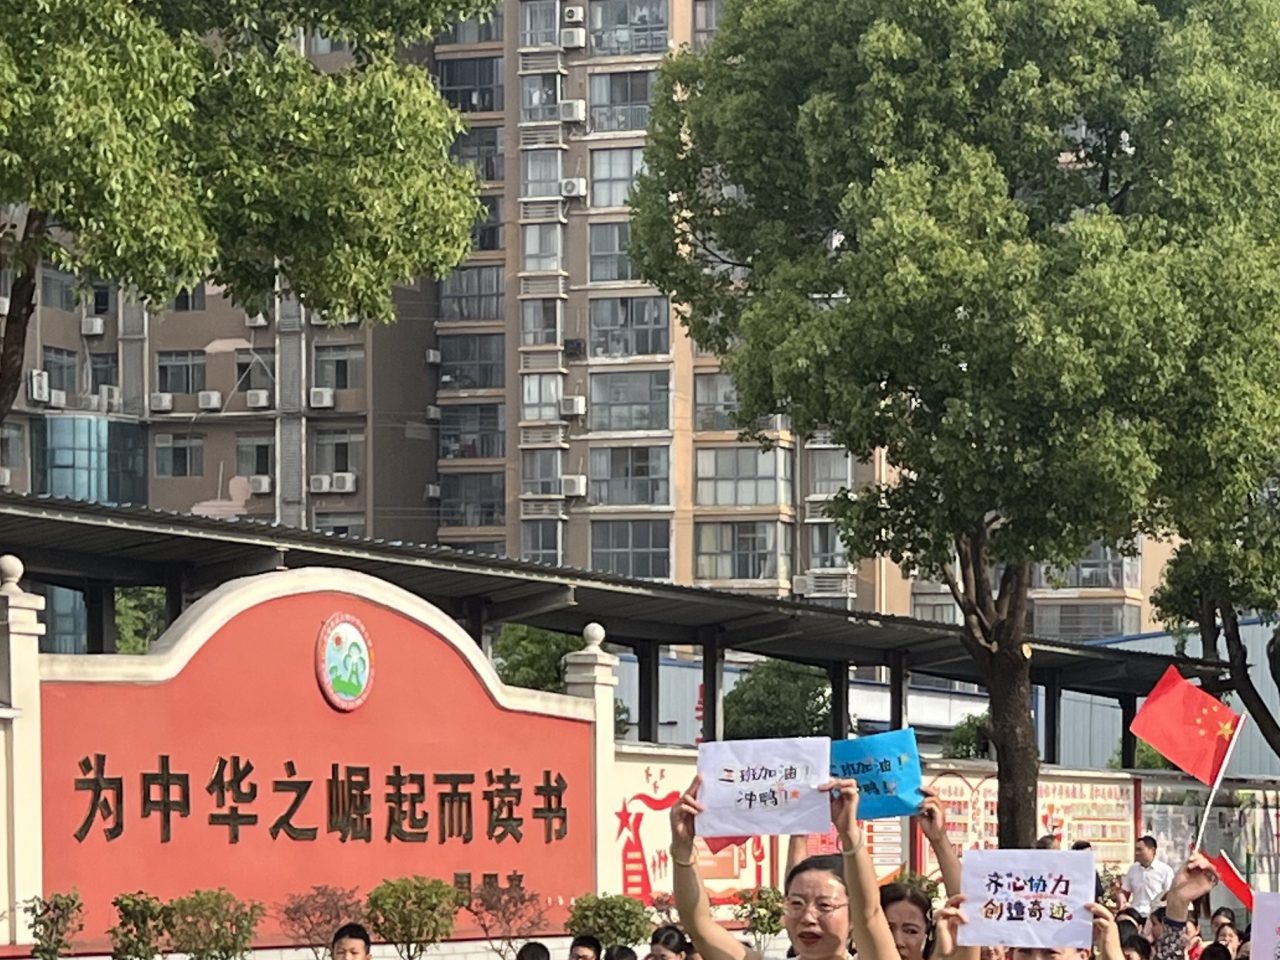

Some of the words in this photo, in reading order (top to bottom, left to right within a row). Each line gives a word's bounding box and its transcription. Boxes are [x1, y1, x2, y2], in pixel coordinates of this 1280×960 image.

[73, 752, 570, 844] 为中华之崛起而读书
[985, 871, 1070, 896] 齐心协力
[983, 898, 1067, 922] 创造奇迹
